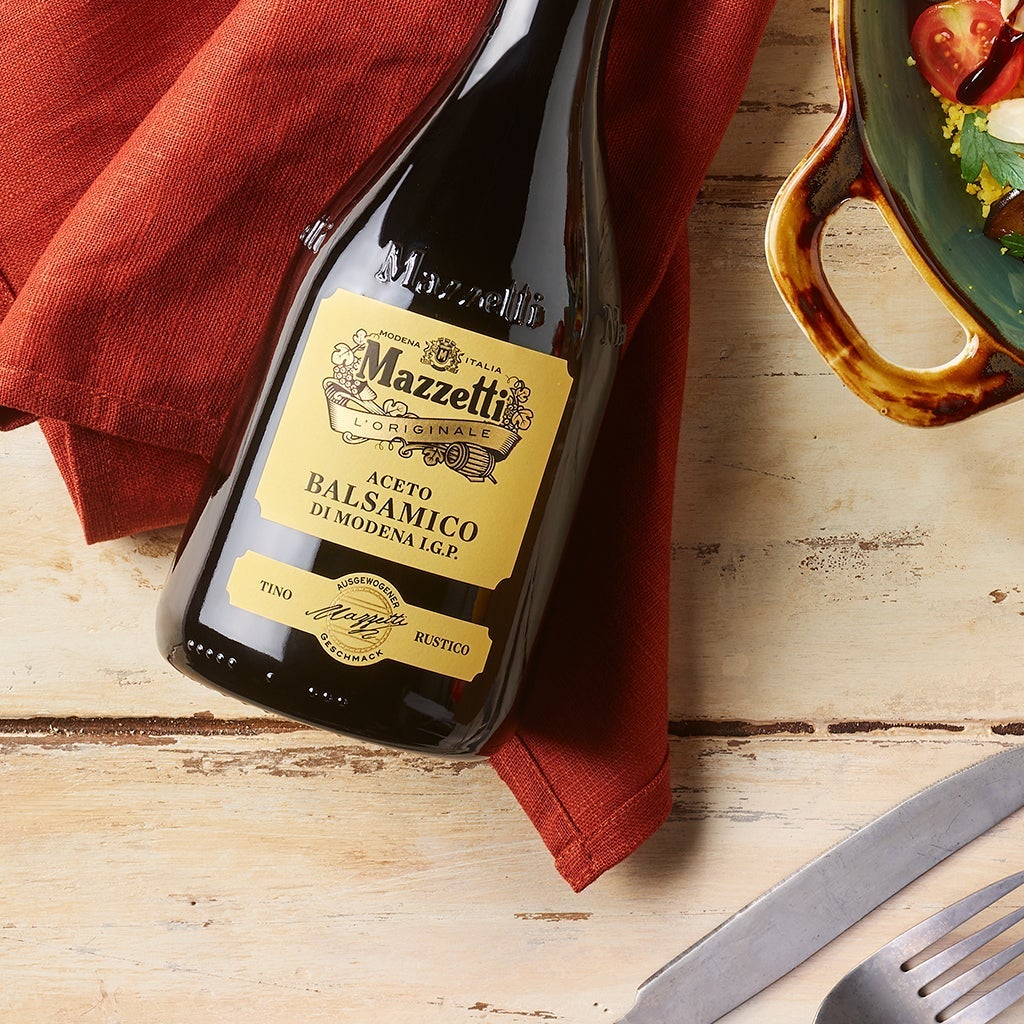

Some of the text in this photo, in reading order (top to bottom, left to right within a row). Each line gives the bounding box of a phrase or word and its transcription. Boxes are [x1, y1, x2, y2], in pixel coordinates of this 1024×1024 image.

[374, 239, 546, 329] Mazzetti
[378, 329, 503, 374] MODENA ITALIA
[356, 338, 509, 422] Mazzetti
[353, 418, 492, 439] L'ORIGINALE
[366, 470, 433, 502] ACETO
[303, 470, 480, 544] BALSAMICO
[309, 501, 459, 561] DI MODENA I.G.P.
[259, 579, 293, 601] TINO
[336, 576, 400, 609] AUSGEWOGENER
[319, 632, 385, 663] GESCHMACK
[413, 630, 471, 657] RUSTICO
